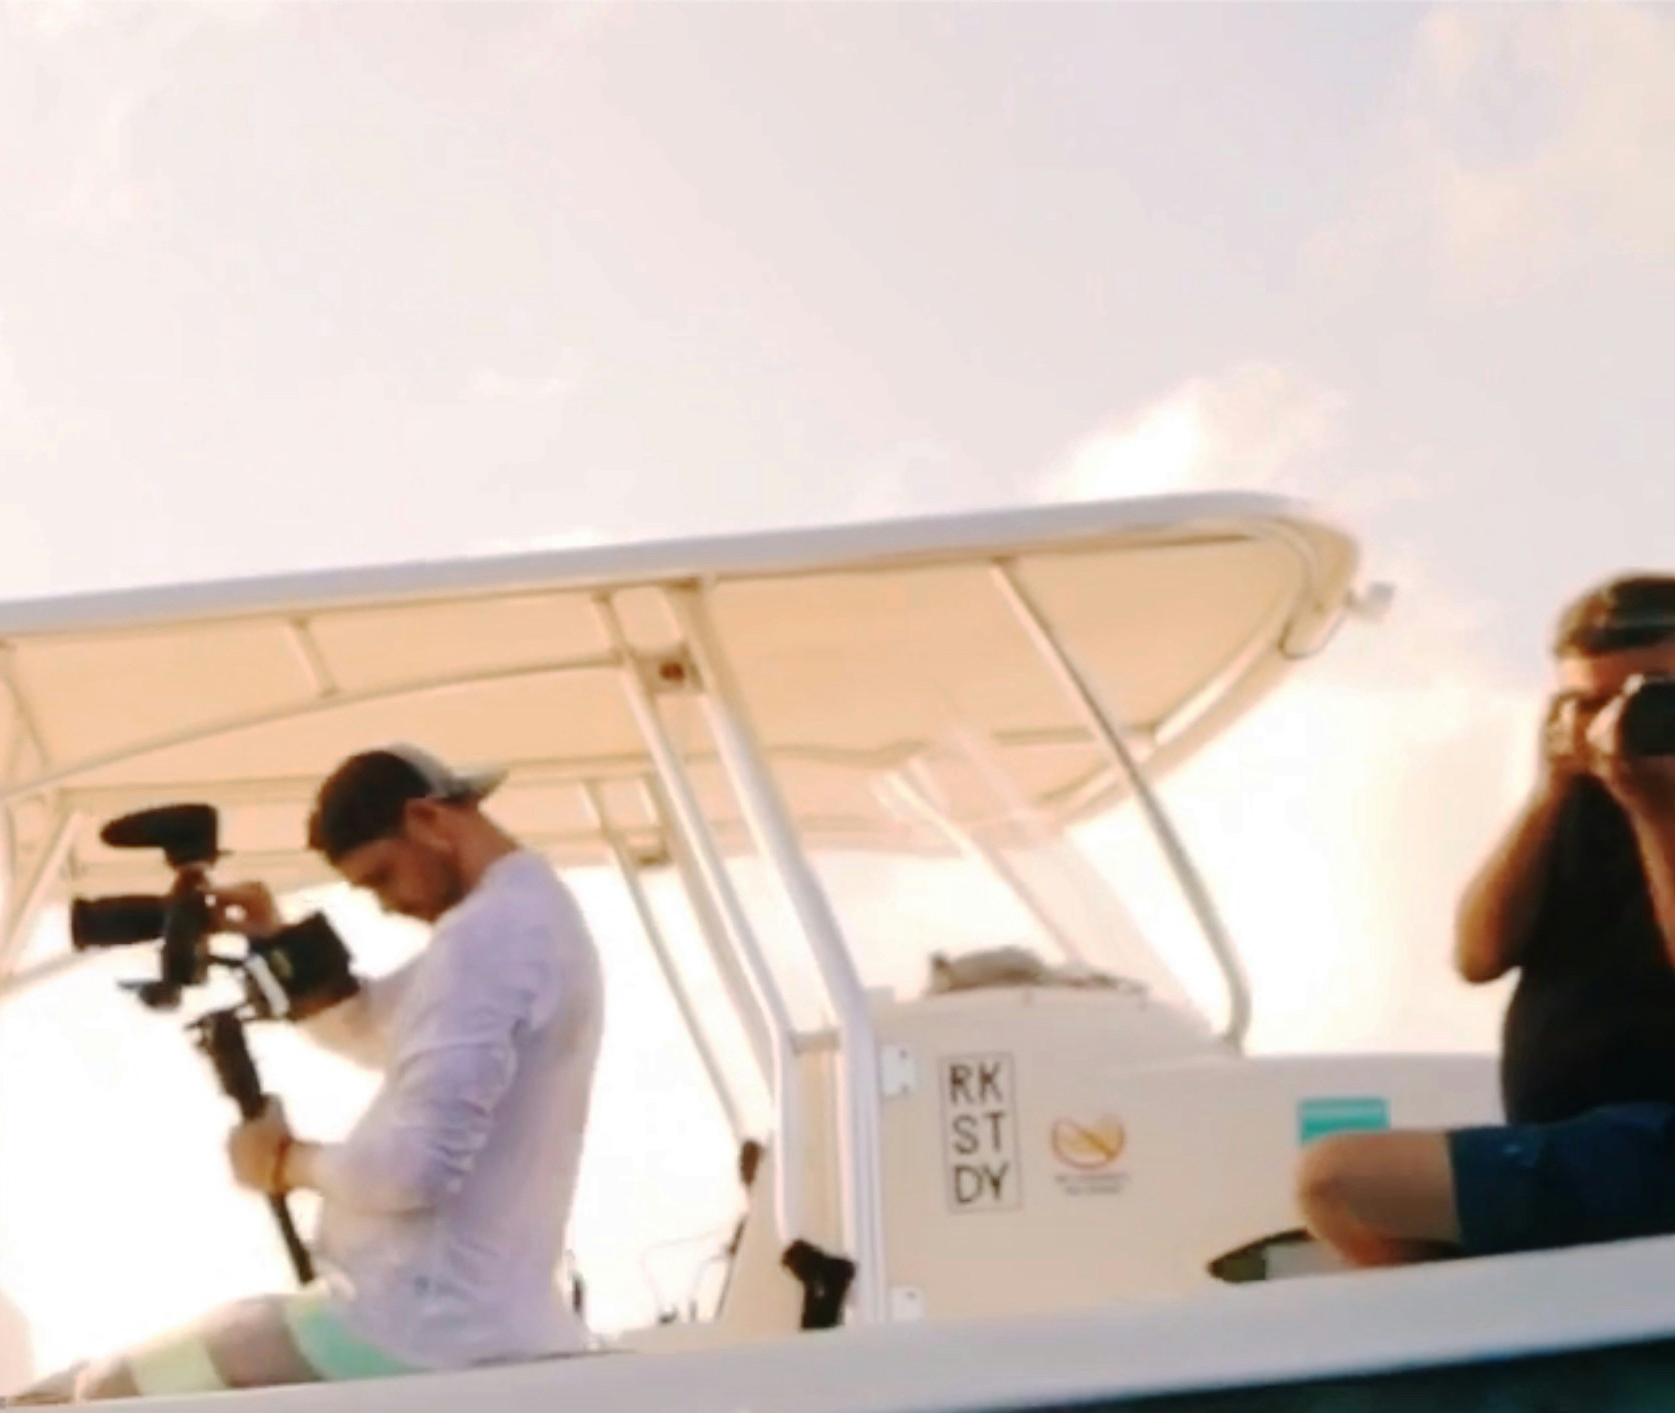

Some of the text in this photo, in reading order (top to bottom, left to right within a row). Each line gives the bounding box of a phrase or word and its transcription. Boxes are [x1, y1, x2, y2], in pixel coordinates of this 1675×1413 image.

[949, 1061, 1003, 1104] RK
[951, 1110, 1006, 1155] ST
[953, 1159, 1011, 1205] DY
